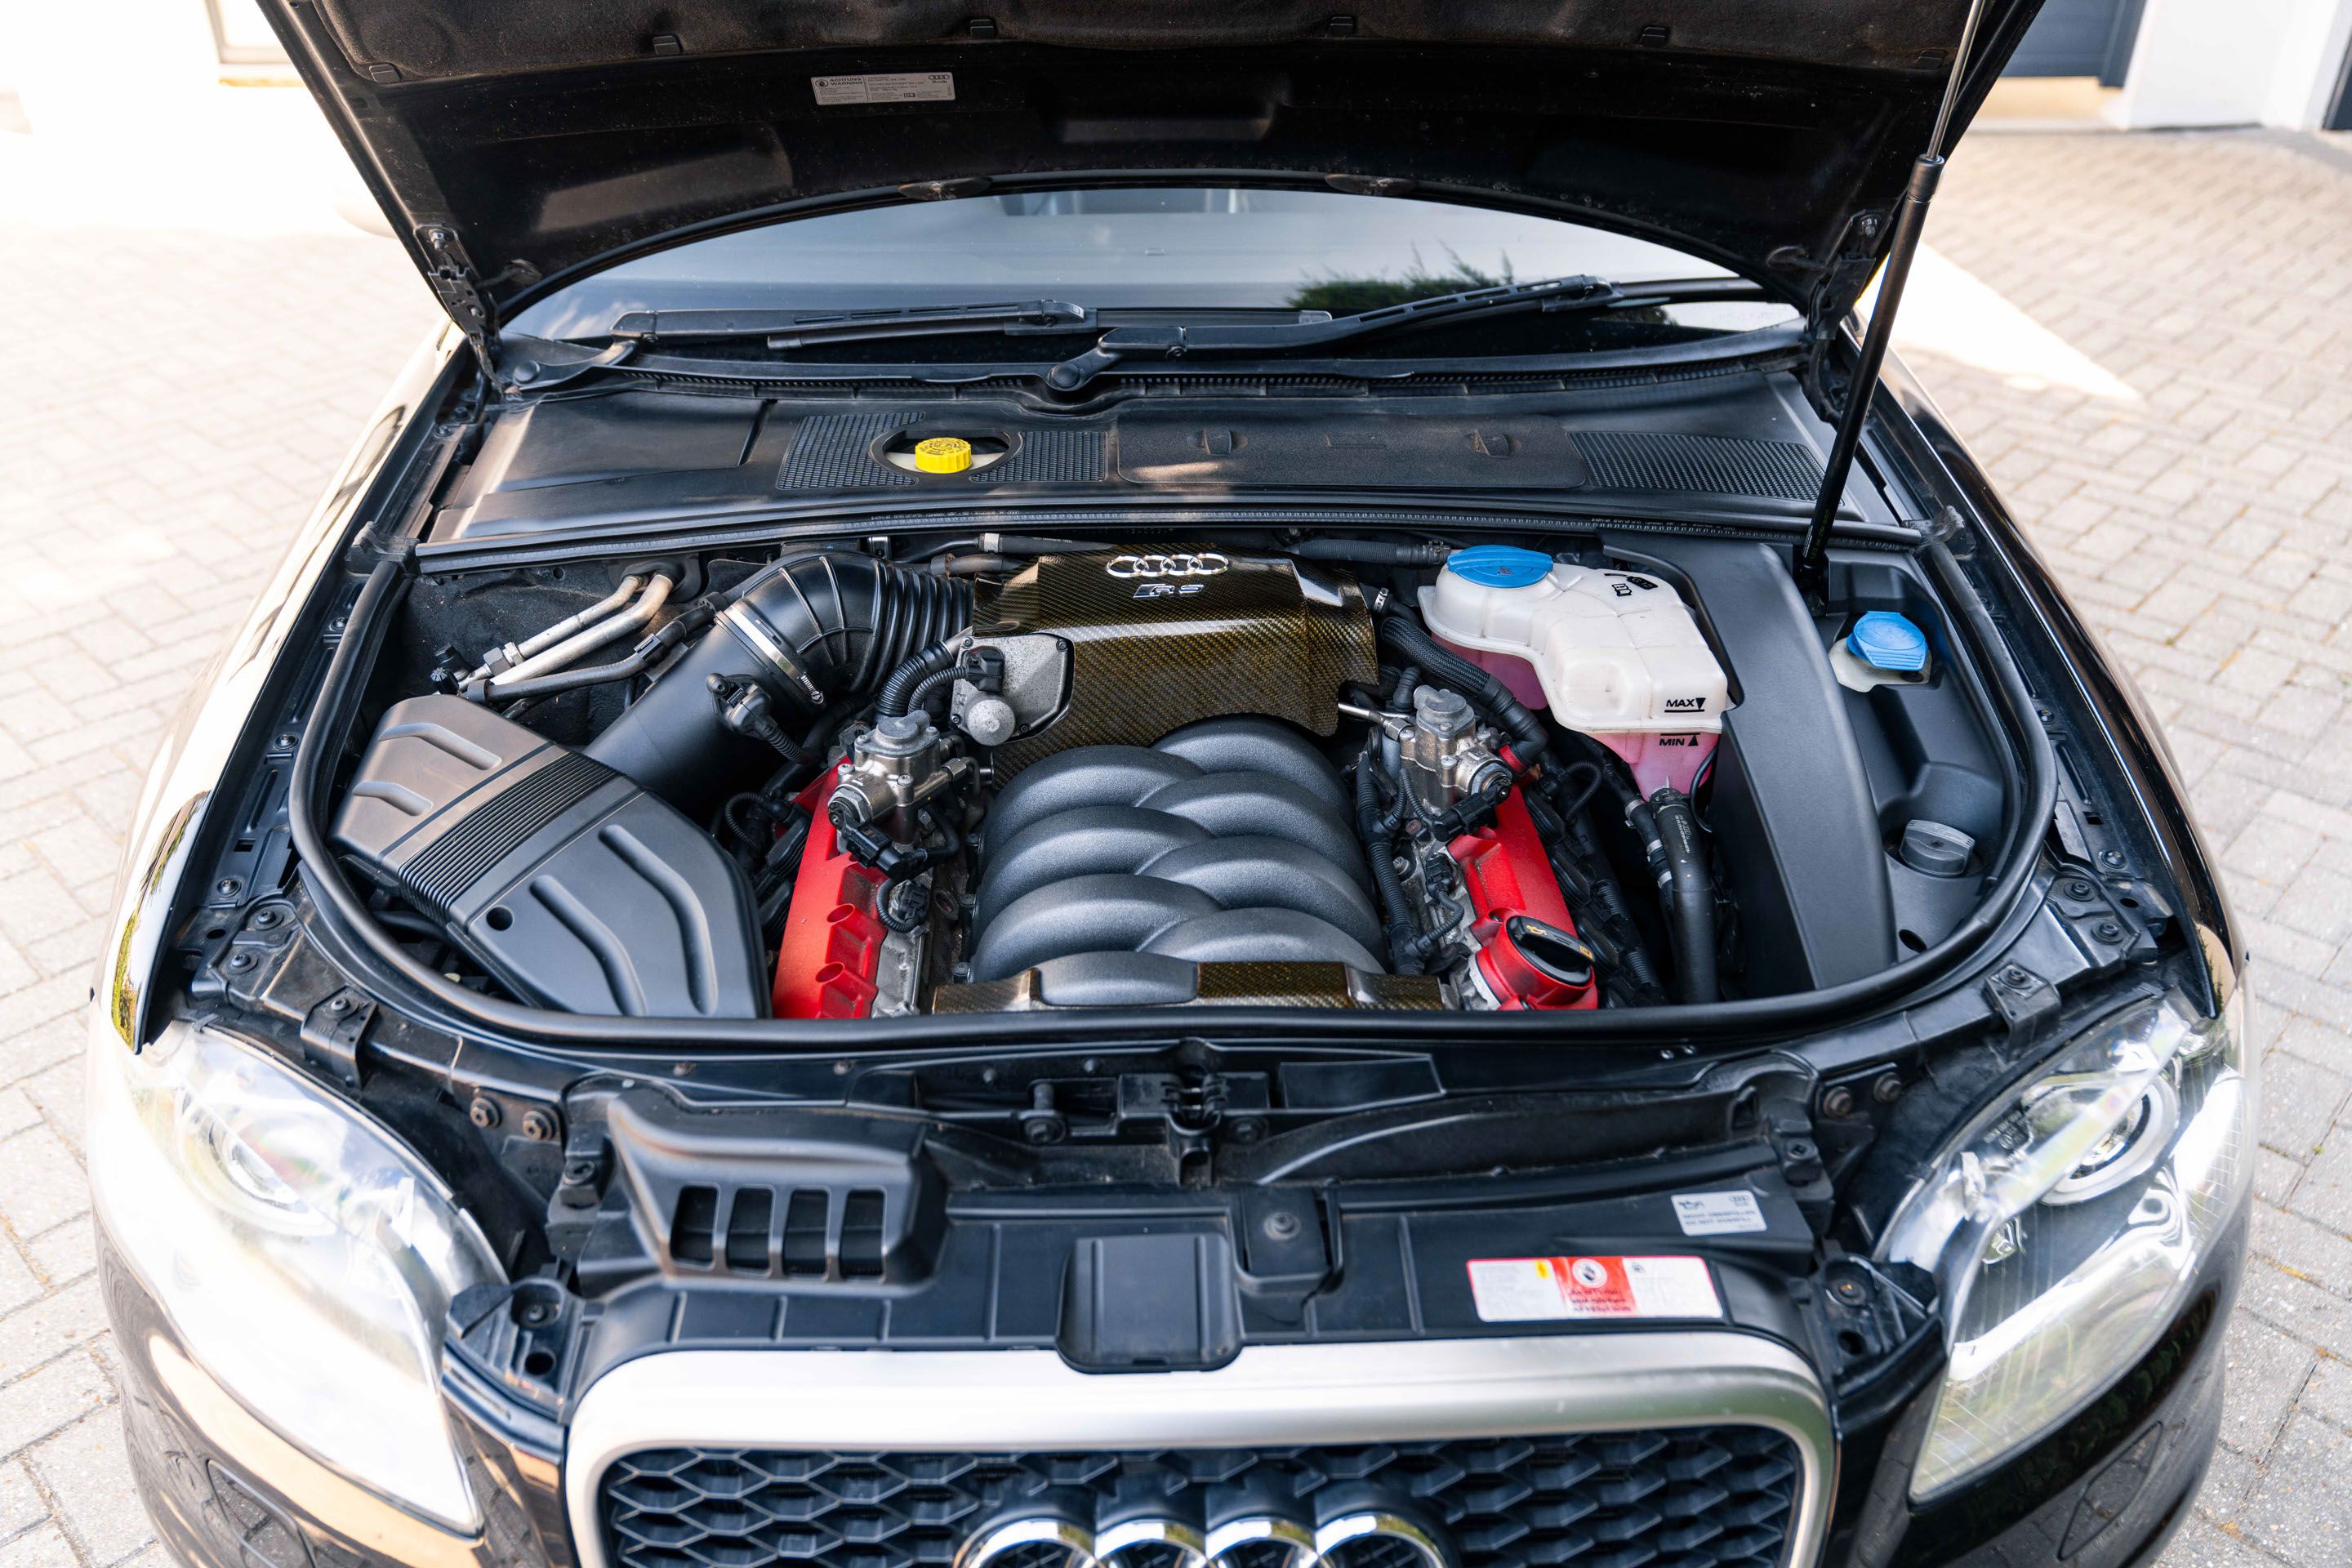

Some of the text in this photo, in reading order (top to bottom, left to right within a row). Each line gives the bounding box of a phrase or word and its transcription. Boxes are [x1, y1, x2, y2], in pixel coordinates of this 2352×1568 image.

[1140, 584, 1204, 597] RS
[1666, 699, 1695, 707] MAX
[1659, 737, 1685, 746] MIN
